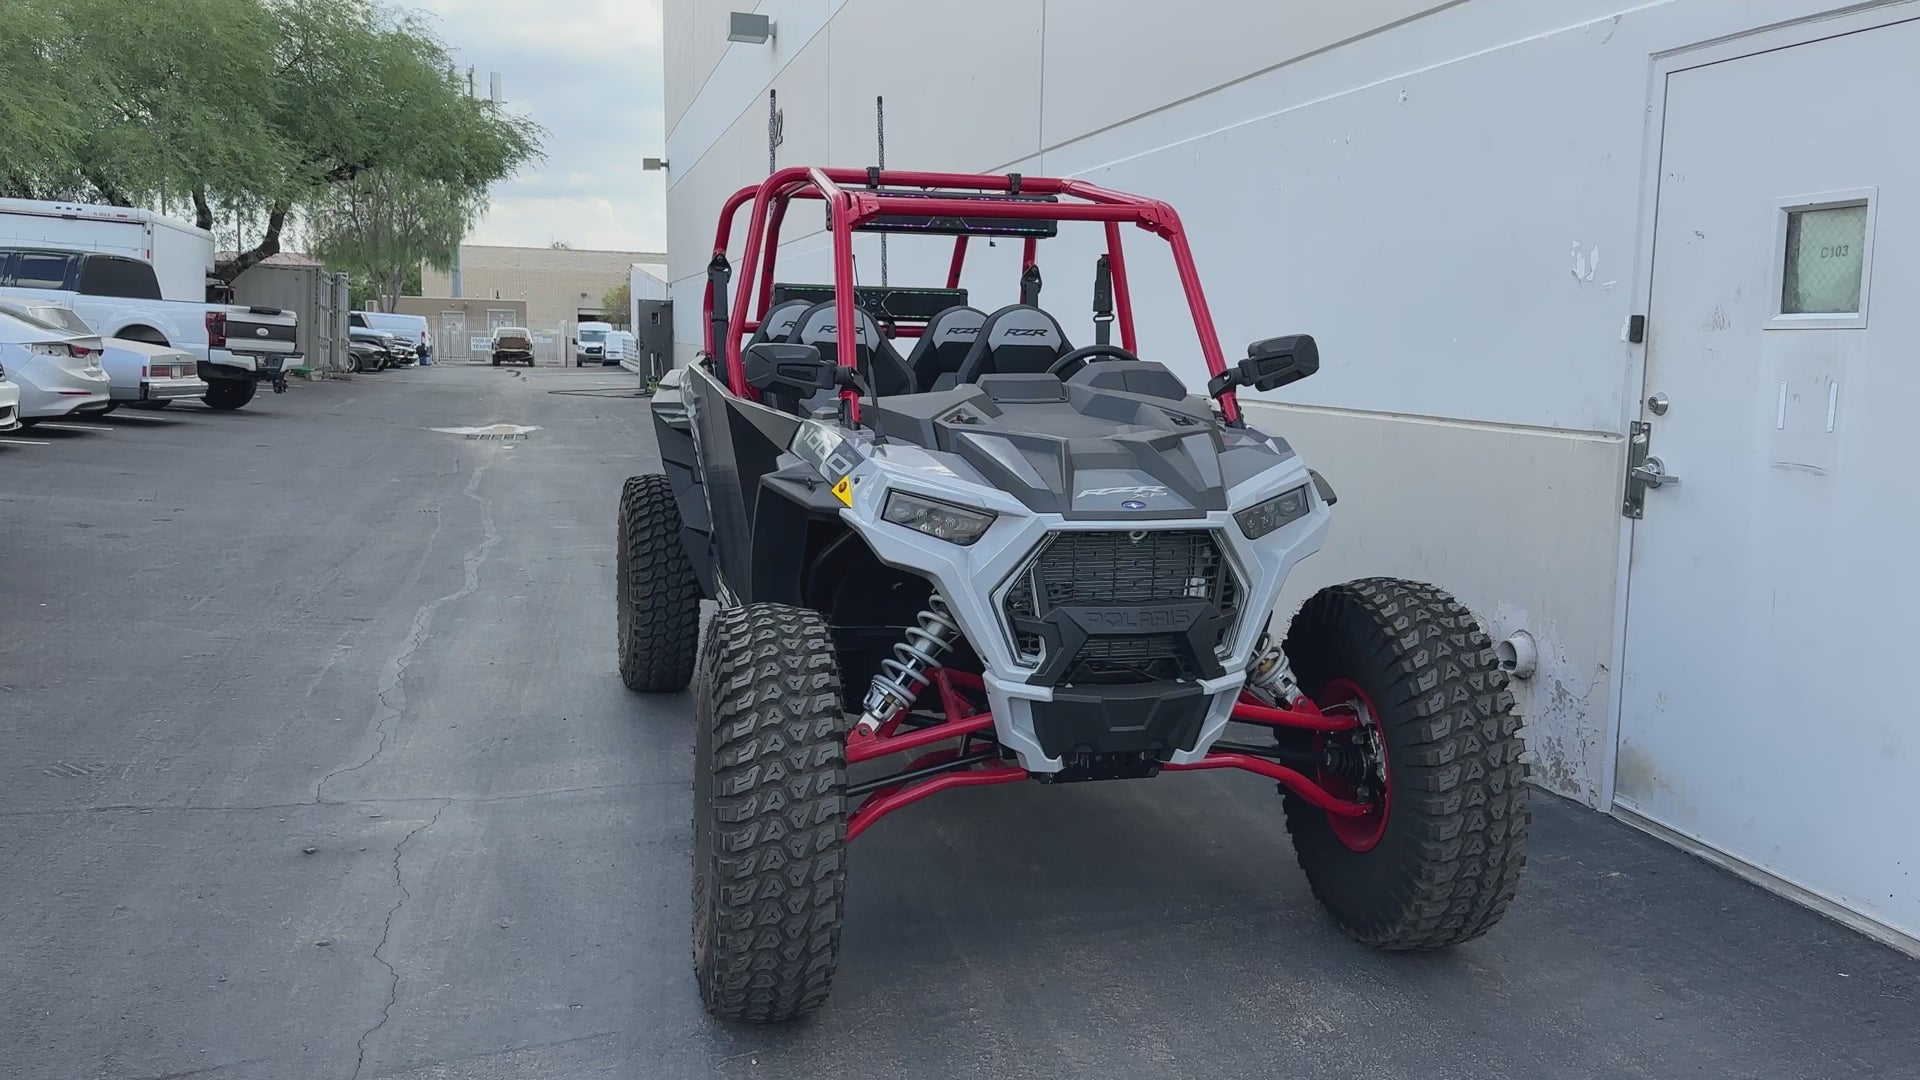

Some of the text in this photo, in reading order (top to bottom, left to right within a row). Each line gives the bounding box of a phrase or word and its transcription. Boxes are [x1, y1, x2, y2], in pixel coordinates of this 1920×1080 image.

[1820, 245, 1849, 258] C103
[1003, 328, 1048, 336] RZR
[1084, 609, 1190, 627] POLARIS
